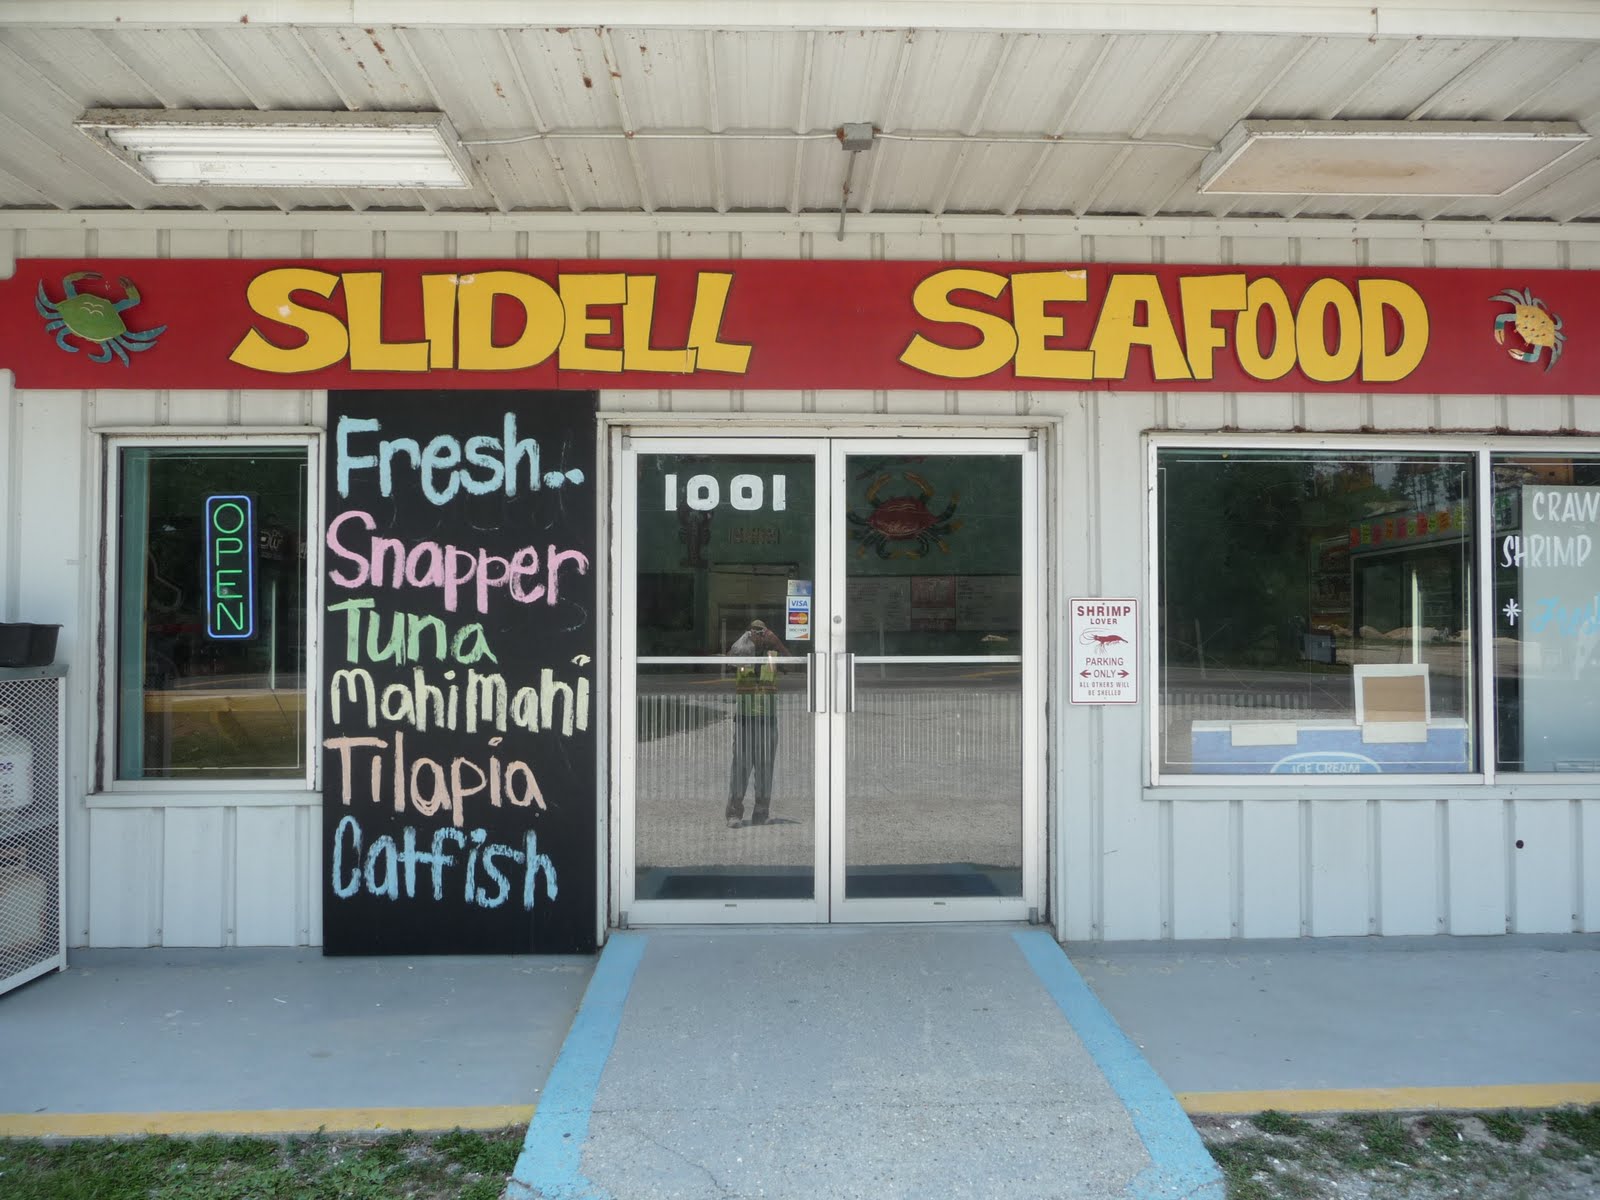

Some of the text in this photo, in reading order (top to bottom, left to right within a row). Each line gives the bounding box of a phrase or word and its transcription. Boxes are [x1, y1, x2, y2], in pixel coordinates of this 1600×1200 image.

[228, 267, 1430, 384] SLIDELL SEAFOOD
[665, 474, 786, 511] 1001
[213, 503, 244, 631] OPEN
[326, 510, 589, 614] Snapper
[1500, 534, 1592, 567] SHRIMP
[327, 598, 498, 666] Tuna
[1077, 606, 1131, 616] SHRIMP
[1085, 657, 1124, 666] PARKING
[1093, 669, 1117, 678] ONLY
[323, 731, 547, 827] Tilapia
[1291, 762, 1360, 773] ICE CREAM
[332, 815, 559, 911] Catfish
